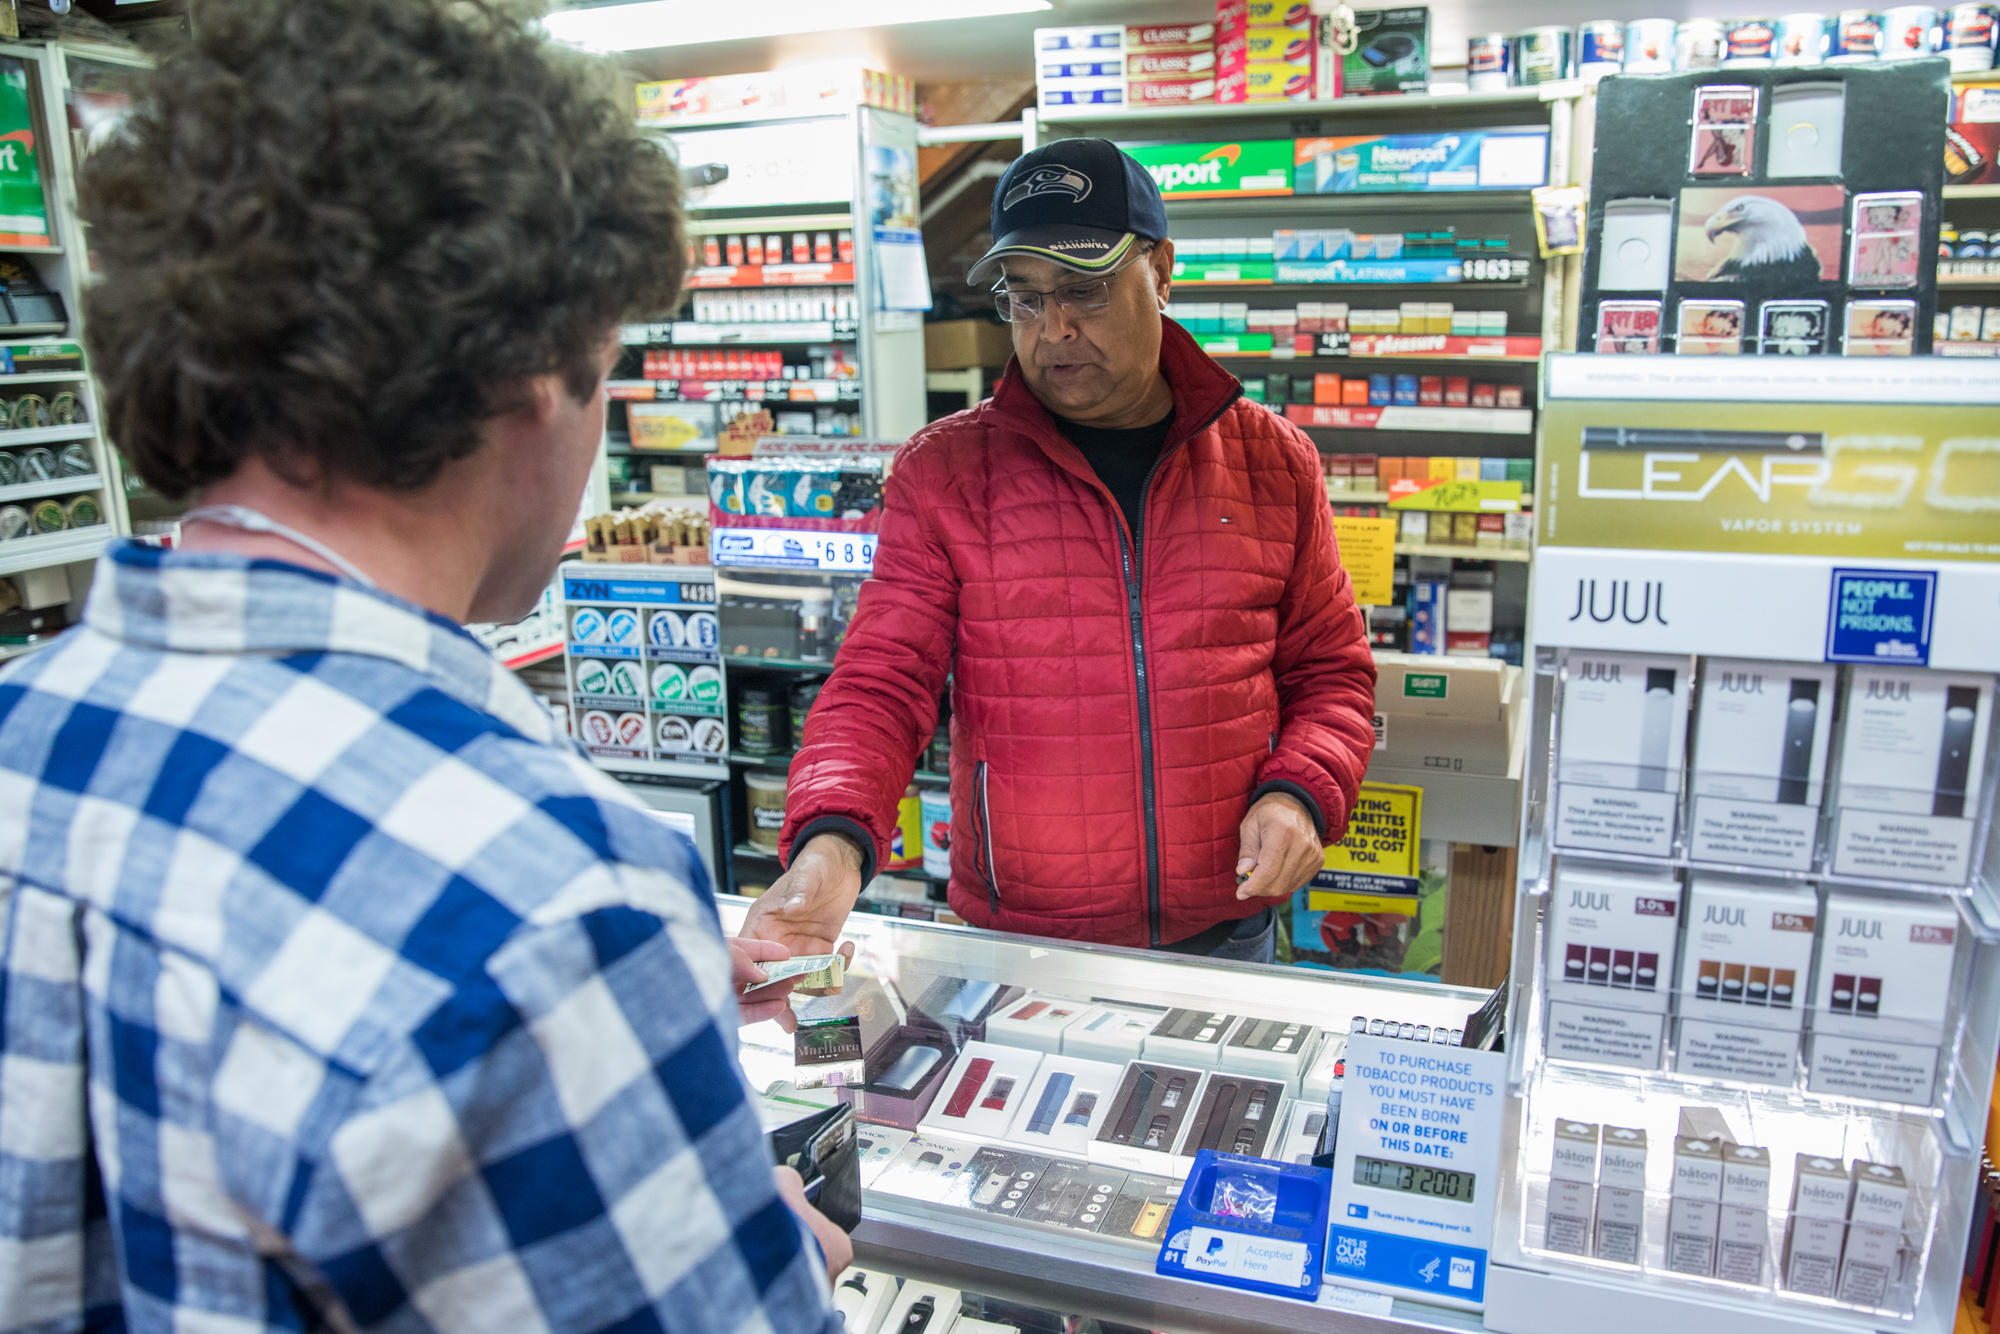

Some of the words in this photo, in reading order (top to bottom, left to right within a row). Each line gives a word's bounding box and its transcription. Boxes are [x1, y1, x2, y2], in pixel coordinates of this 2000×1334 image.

[1371, 145, 1448, 164] Newport
[1048, 242, 1110, 250] SEAHAWKS
[1374, 335, 1446, 354] pleasure
[1578, 450, 1832, 503] LEAP
[1720, 518, 1782, 533] VAPOR
[1789, 520, 1862, 535] SYSTEM
[570, 580, 609, 599] ZYN
[1568, 579, 1669, 625] JUUL
[1842, 599, 1876, 614] NOT
[1578, 662, 1622, 683] JUUL
[1718, 672, 1763, 694] JUUL
[1866, 680, 1912, 702] JUUL
[1350, 811, 1405, 826] ARETTES
[1356, 825, 1406, 840] MINORS
[1372, 840, 1406, 852] COST
[1349, 850, 1380, 864] YOU.
[1569, 890, 1611, 912] JUUL
[1703, 904, 1746, 927] JUUL
[1838, 917, 1884, 940] JUUL
[798, 1039, 859, 1057] Marlboro
[1379, 1052, 1396, 1065] TO
[1400, 1055, 1472, 1076] PURCHASE
[1355, 1065, 1417, 1086] TOBACCO
[1420, 1076, 1494, 1096] PRODUCTS
[1369, 1084, 1395, 1098] YOU
[1400, 1088, 1436, 1104] MUST
[1440, 1094, 1476, 1110] HAVE
[1381, 1103, 1416, 1119] BEEN
[1422, 1108, 1460, 1125] BORN
[1370, 1118, 1388, 1131] ON
[1392, 1122, 1410, 1134] OR
[1414, 1124, 1468, 1144] BEFORE
[1381, 1136, 1410, 1152] THIS
[1414, 1142, 1454, 1158] DATE:
[1373, 1210, 1392, 1219] Thank
[1394, 1214, 1404, 1222] you
[1418, 1218, 1444, 1230] showing
[1446, 1223, 1460, 1231] your
[1336, 1244, 1367, 1259] OUR
[1338, 1236, 1358, 1248] THIS
[1358, 1239, 1368, 1248] IS
[1164, 1250, 1178, 1263] #1
[1196, 1256, 1228, 1268] PayPal
[1246, 1244, 1294, 1261] Accepted
[1336, 1254, 1366, 1267] WATCH
[1242, 1260, 1268, 1271] Here
[1452, 1263, 1472, 1274] FDA
